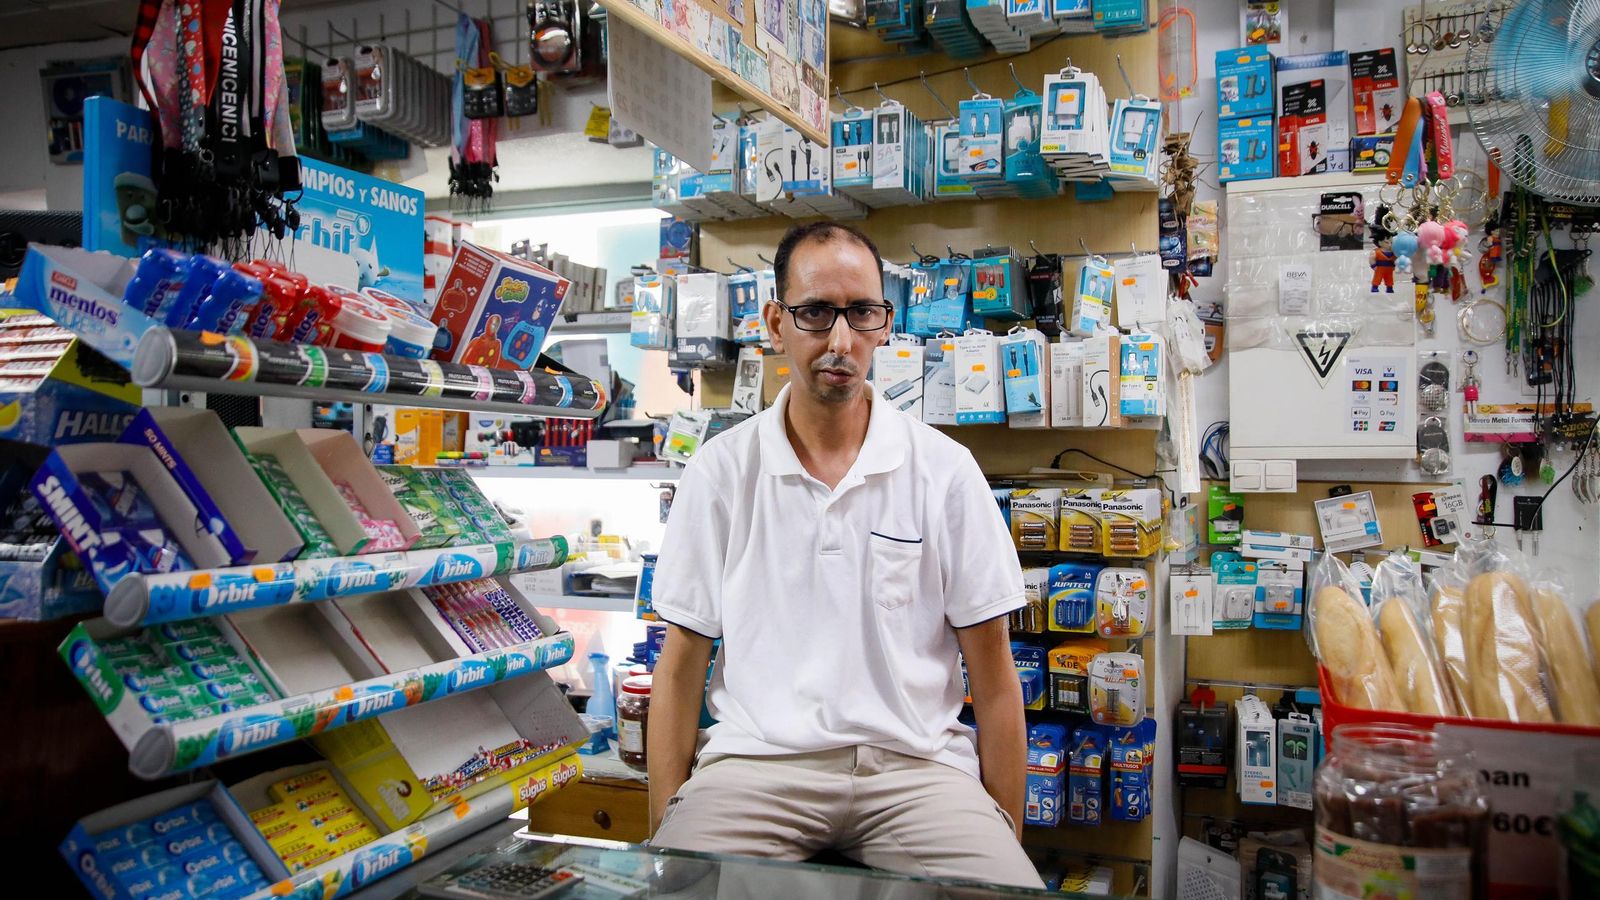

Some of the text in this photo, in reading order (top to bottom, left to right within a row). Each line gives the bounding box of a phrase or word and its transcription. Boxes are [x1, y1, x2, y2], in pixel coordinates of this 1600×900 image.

[359, 188, 368, 203] Y
[370, 186, 419, 217] SANOS
[50, 286, 119, 327] mentos
[37, 475, 101, 552] SMINT
[1012, 501, 1052, 509] Panasonic
[1062, 499, 1102, 508] Panasonic
[1103, 503, 1144, 511] Panasonic
[1444, 499, 1464, 509] 16GB
[431, 557, 475, 584] Orbit
[517, 545, 551, 571] Orbit
[327, 570, 378, 598] Orbit
[1051, 581, 1092, 589] JUPITER
[540, 642, 568, 668] Orbit
[447, 665, 487, 693] Orbit
[346, 690, 396, 722] Orbit
[216, 718, 282, 759] Orbit
[551, 764, 577, 785] sugus
[1044, 779, 1052, 787] 7g
[1089, 780, 1097, 788] 7g
[520, 779, 548, 801] sugus
[352, 848, 401, 877] Orbit
